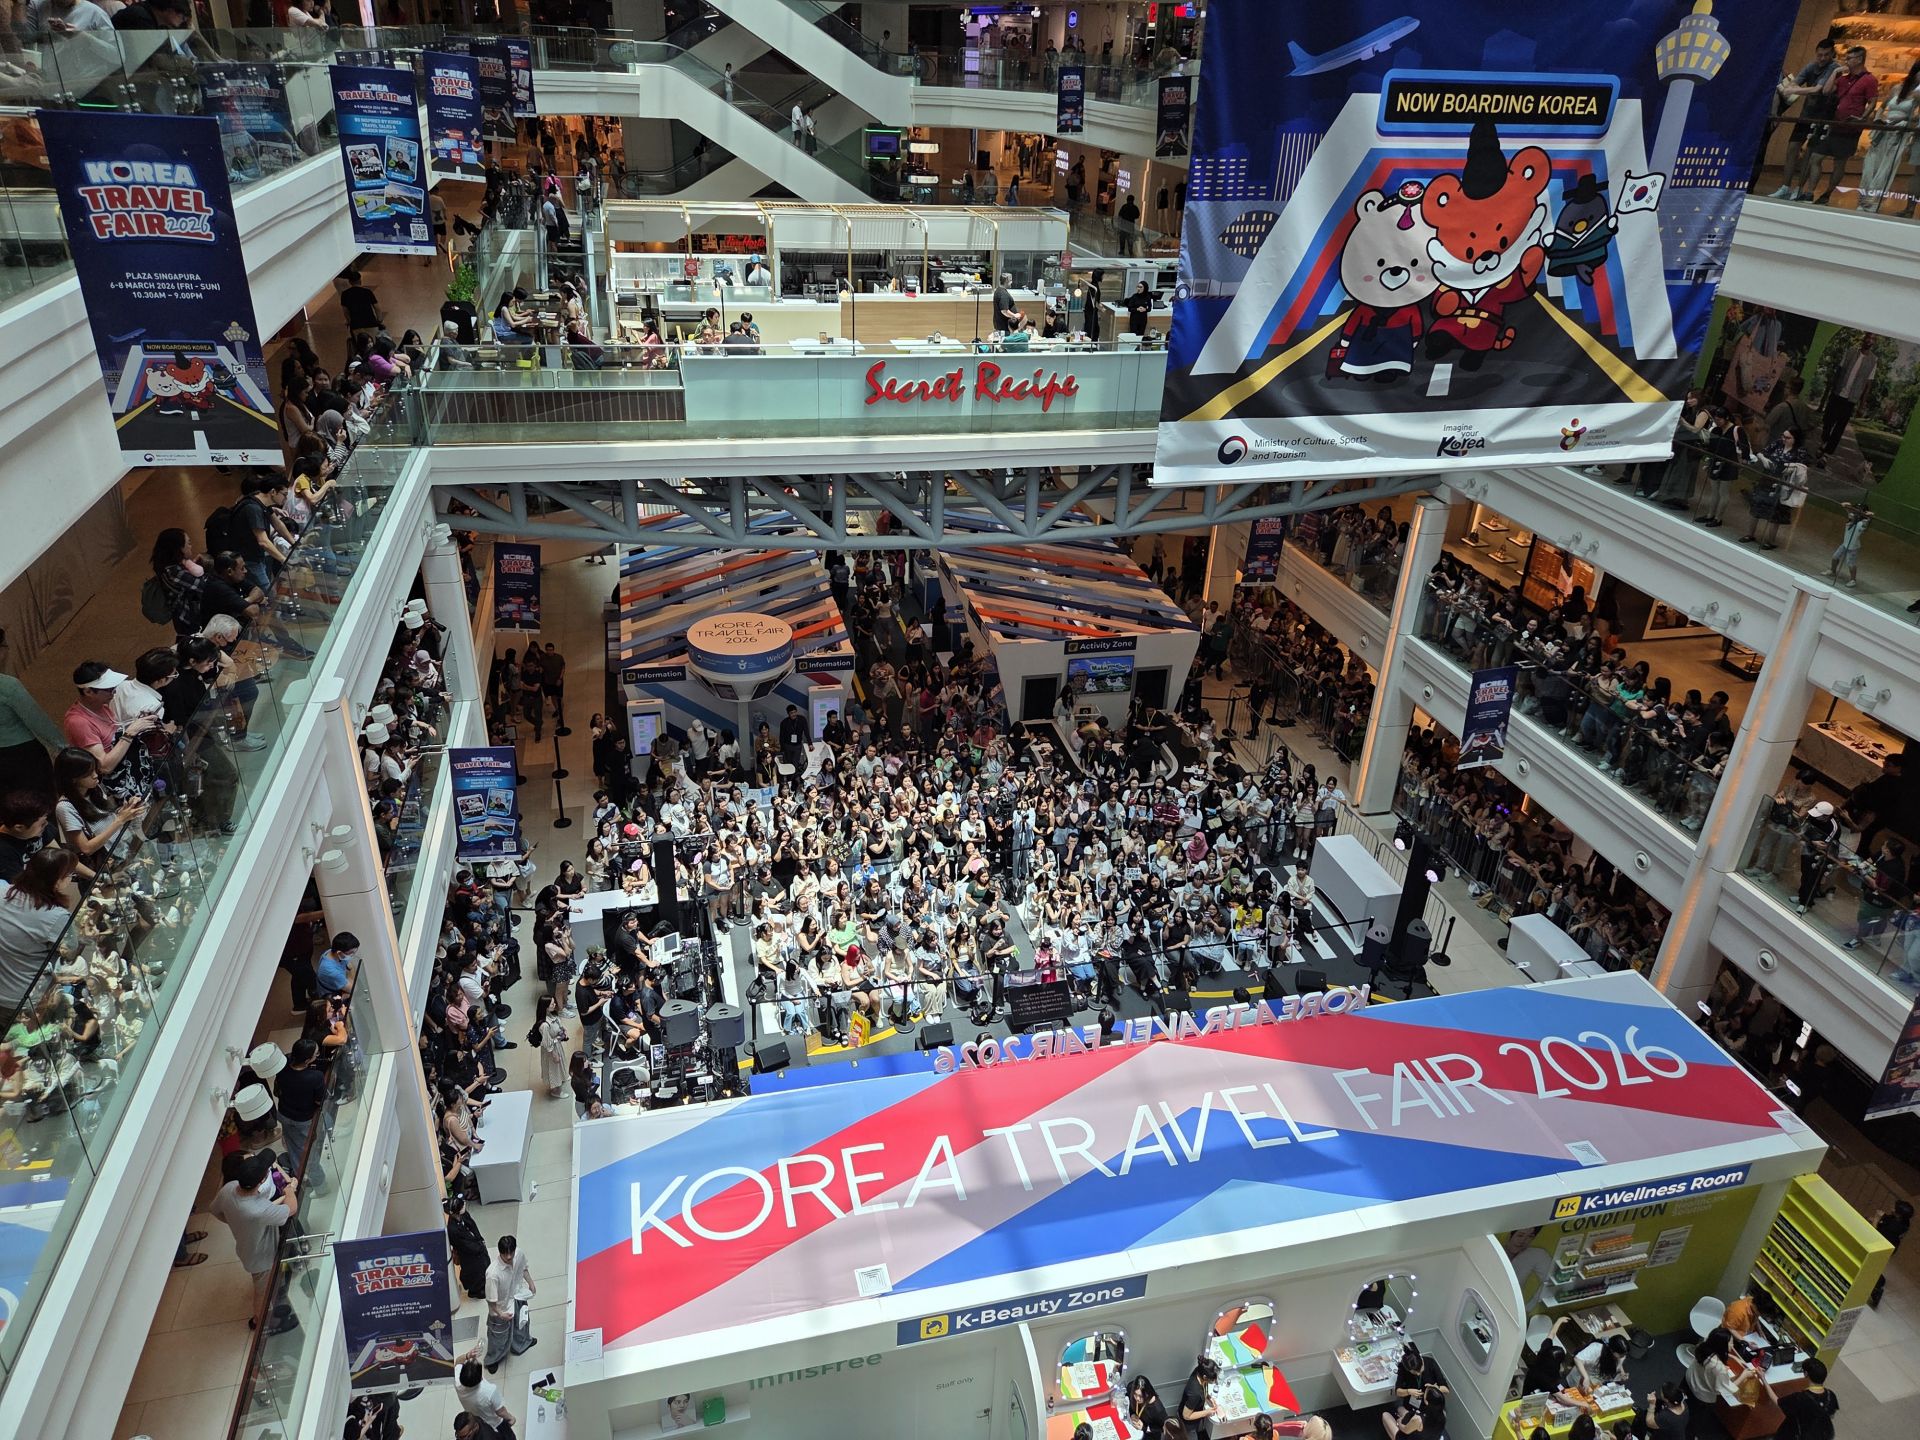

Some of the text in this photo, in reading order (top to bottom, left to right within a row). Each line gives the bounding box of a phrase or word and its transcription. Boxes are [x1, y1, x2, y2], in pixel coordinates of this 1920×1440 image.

[359, 83, 389, 92] KOREA
[431, 76, 473, 91] TRAVEL
[338, 91, 375, 100] TRAVEL
[376, 91, 398, 102] FAIR
[433, 86, 458, 97] FAIR
[1396, 93, 1598, 115] NOW BOARDING KOREA
[84, 160, 197, 187] KOREA
[78, 185, 214, 216] TRAVEL
[89, 212, 212, 240] FAIR 2026
[125, 272, 202, 281] PLAZA SINGAPURA
[125, 282, 155, 290] MARCH
[132, 291, 167, 299] 10.30AM
[864, 360, 1080, 413] Secret Recipe
[1443, 423, 1473, 433] Imagine
[1460, 430, 1480, 438] your
[1254, 435, 1368, 449] Ministry of Culture, Sports
[1437, 436, 1485, 457] Korea
[1252, 451, 1307, 460] and Tourism
[713, 621, 765, 629] KOREA
[696, 627, 785, 638] TRAVEL FAIR
[725, 636, 758, 644] 2026
[1079, 640, 1133, 650] Activity Zone
[809, 660, 851, 668] Information
[637, 671, 682, 679] Information
[630, 1025, 1687, 1255] KOREA TRAVEL FAIR 2026
[1583, 1182, 1687, 1211] K-Wellness
[1690, 1170, 1744, 1191] Room
[1561, 1202, 1669, 1233] CONDITION
[357, 1253, 427, 1271] KOREA
[351, 1263, 435, 1284] TRAVEL
[356, 1274, 431, 1295] FAIR 2026
[955, 1286, 1125, 1329] K-Beauty Zone
[935, 1375, 976, 1391] Staff only
